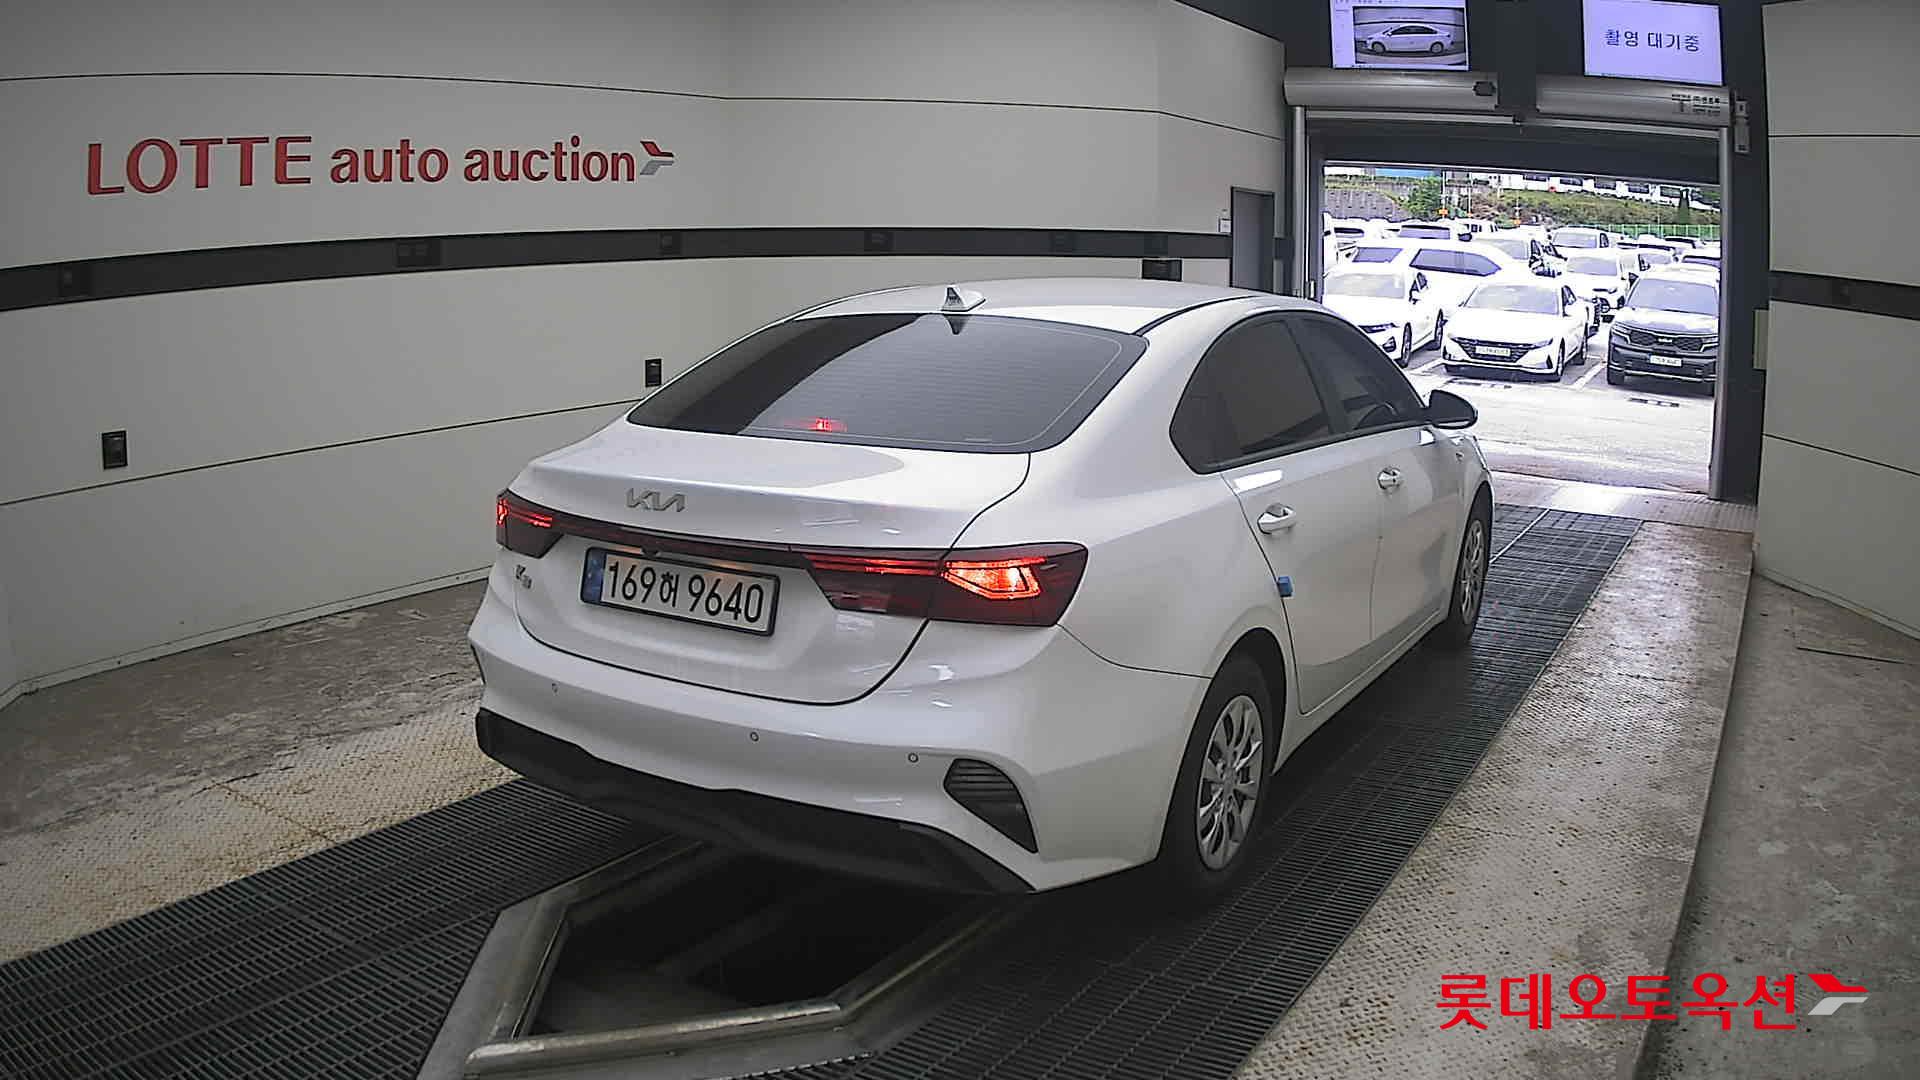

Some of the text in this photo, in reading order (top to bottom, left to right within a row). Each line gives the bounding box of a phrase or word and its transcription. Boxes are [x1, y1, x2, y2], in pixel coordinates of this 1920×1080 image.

[1647, 31, 1700, 52] 대기중
[87, 135, 636, 195] LOTTE auto auction
[607, 561, 764, 623] 169허 9640
